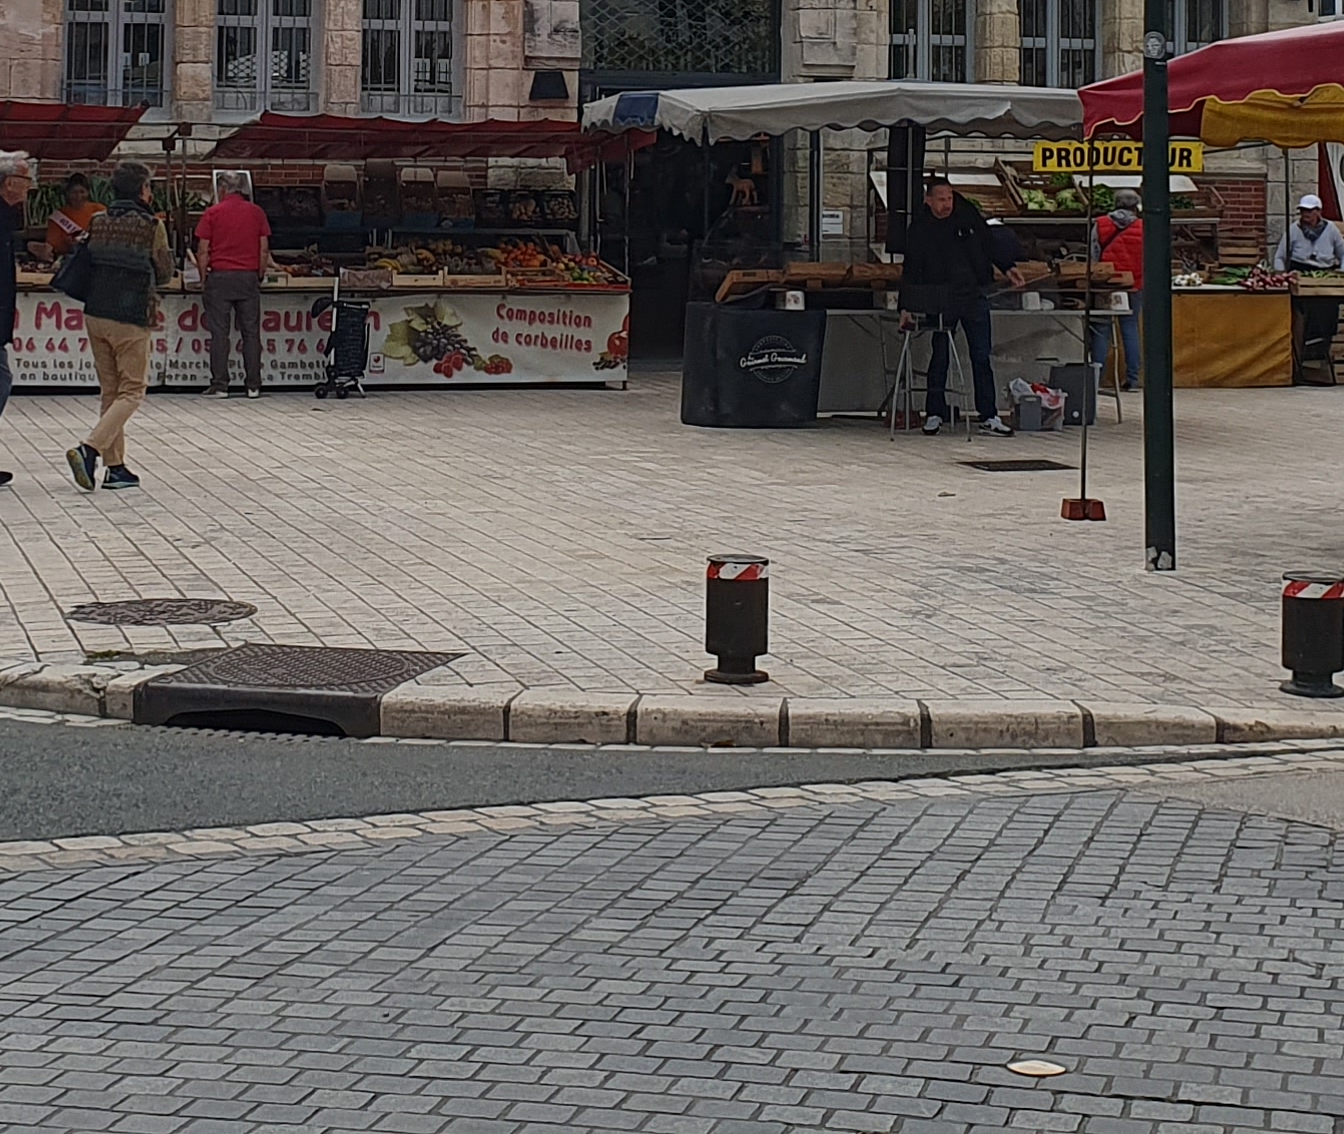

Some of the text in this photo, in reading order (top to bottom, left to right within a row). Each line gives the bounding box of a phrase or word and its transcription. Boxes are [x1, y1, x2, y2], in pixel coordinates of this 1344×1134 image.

[1041, 147, 1192, 168] PRODUCTUR
[496, 303, 593, 328] Composition
[13, 336, 36, 353] 06
[285, 338, 308, 354] 76
[492, 326, 592, 353] de corbeilles
[15, 358, 47, 369] Tous
[53, 358, 74, 369] les
[169, 359, 210, 369] March
[270, 359, 325, 370] Gambett
[20, 373, 36, 381] en
[42, 371, 96, 382] boutiqu
[280, 371, 326, 381] Trembl
